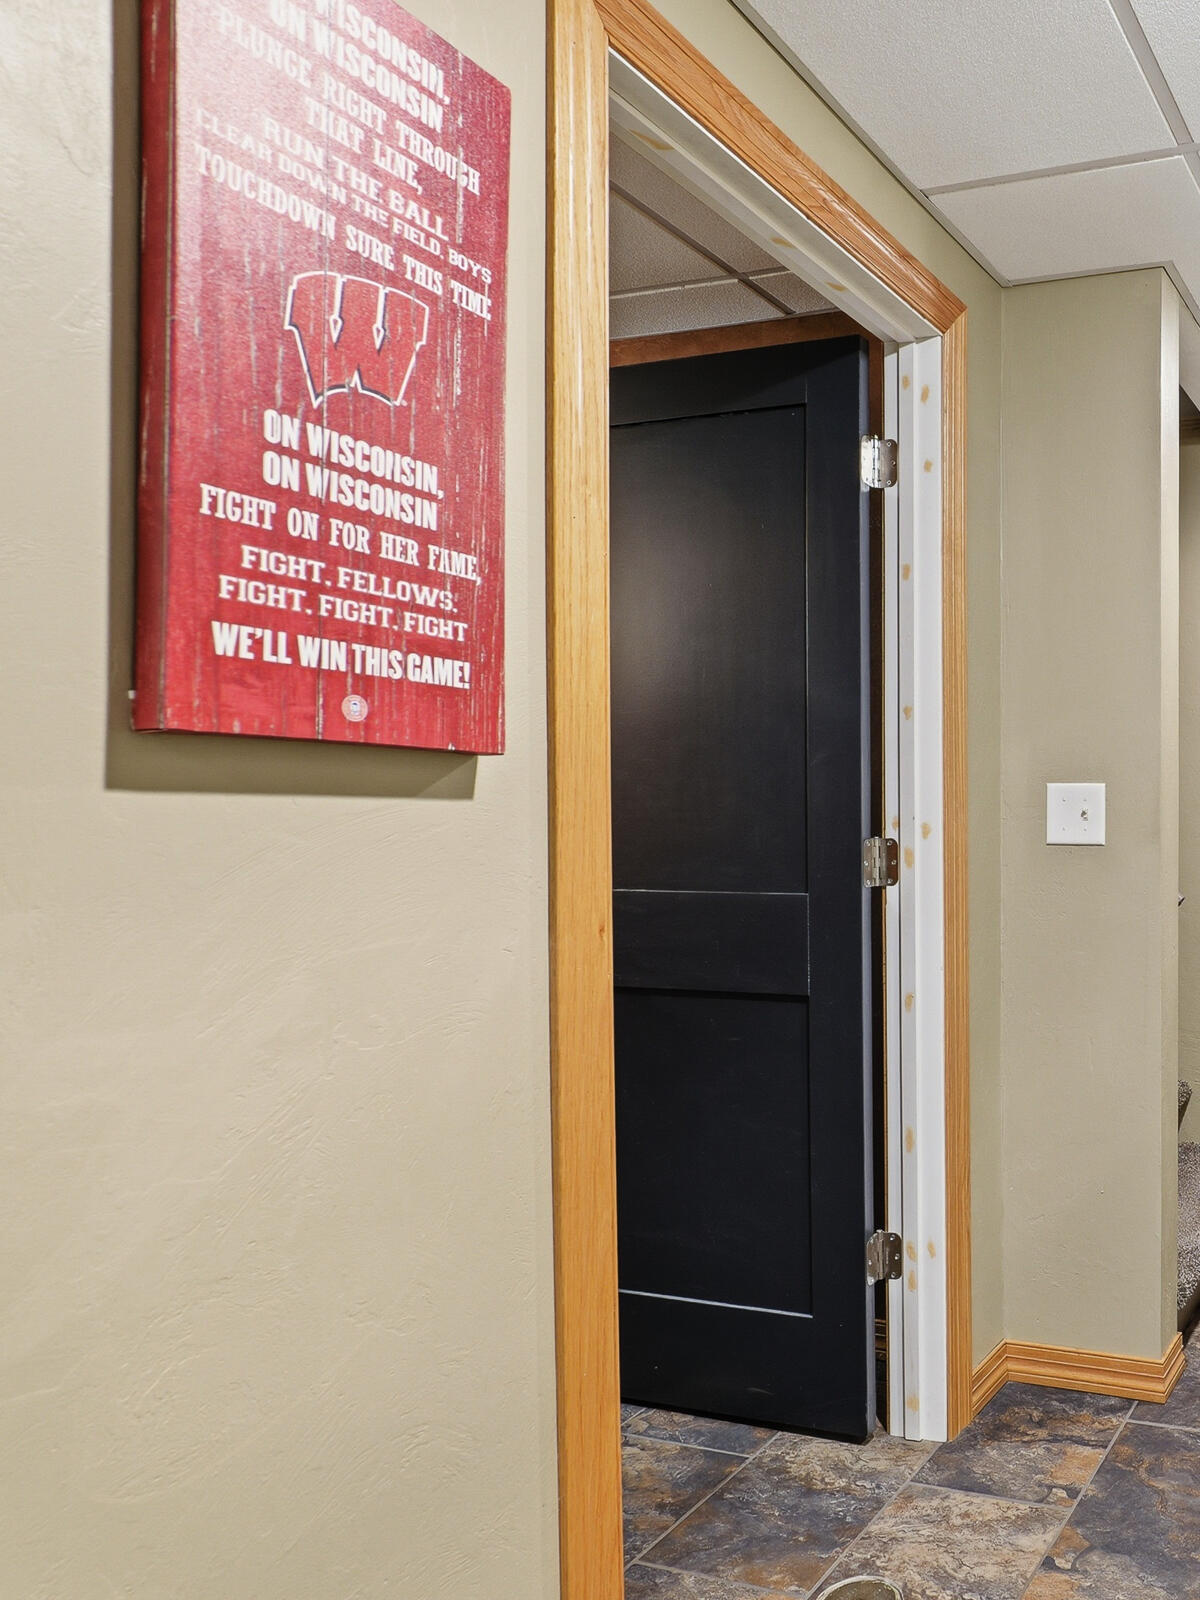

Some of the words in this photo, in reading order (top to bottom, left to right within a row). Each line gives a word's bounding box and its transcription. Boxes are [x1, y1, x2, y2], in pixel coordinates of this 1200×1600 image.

[216, 8, 312, 88] PLUNGE
[323, 72, 387, 135] RIGHT
[396, 119, 481, 197] THROUGH
[269, 0, 306, 42] ON
[311, 18, 443, 133] WISCONSIN
[196, 108, 273, 164] CLEAR
[278, 152, 347, 205] DOWN
[350, 195, 390, 228] THE
[448, 247, 491, 284] BOYS
[264, 116, 326, 170] RUN
[331, 155, 383, 203] THE
[388, 188, 449, 241] BALL
[305, 96, 364, 154] THAT
[373, 137, 423, 195] LINE,
[194, 142, 337, 241] TOUCHDOWN
[346, 224, 395, 271] SURE
[403, 254, 443, 295] THIS
[451, 279, 491, 320] TIME
[263, 408, 299, 451] ON
[306, 421, 444, 499] WISCONSIN,
[263, 450, 299, 492] ON
[306, 462, 438, 531] WISCONSIN
[200, 483, 276, 531] FIGHT
[287, 507, 319, 541] ON
[329, 518, 370, 555] FOR
[379, 530, 420, 567] HER
[427, 543, 481, 586] FAME,
[211, 620, 292, 664] WE'LL
[297, 634, 347, 673] WIN
[352, 643, 403, 680] THIS
[407, 653, 470, 689] GAME!
[403, 611, 468, 642] FIGHT
